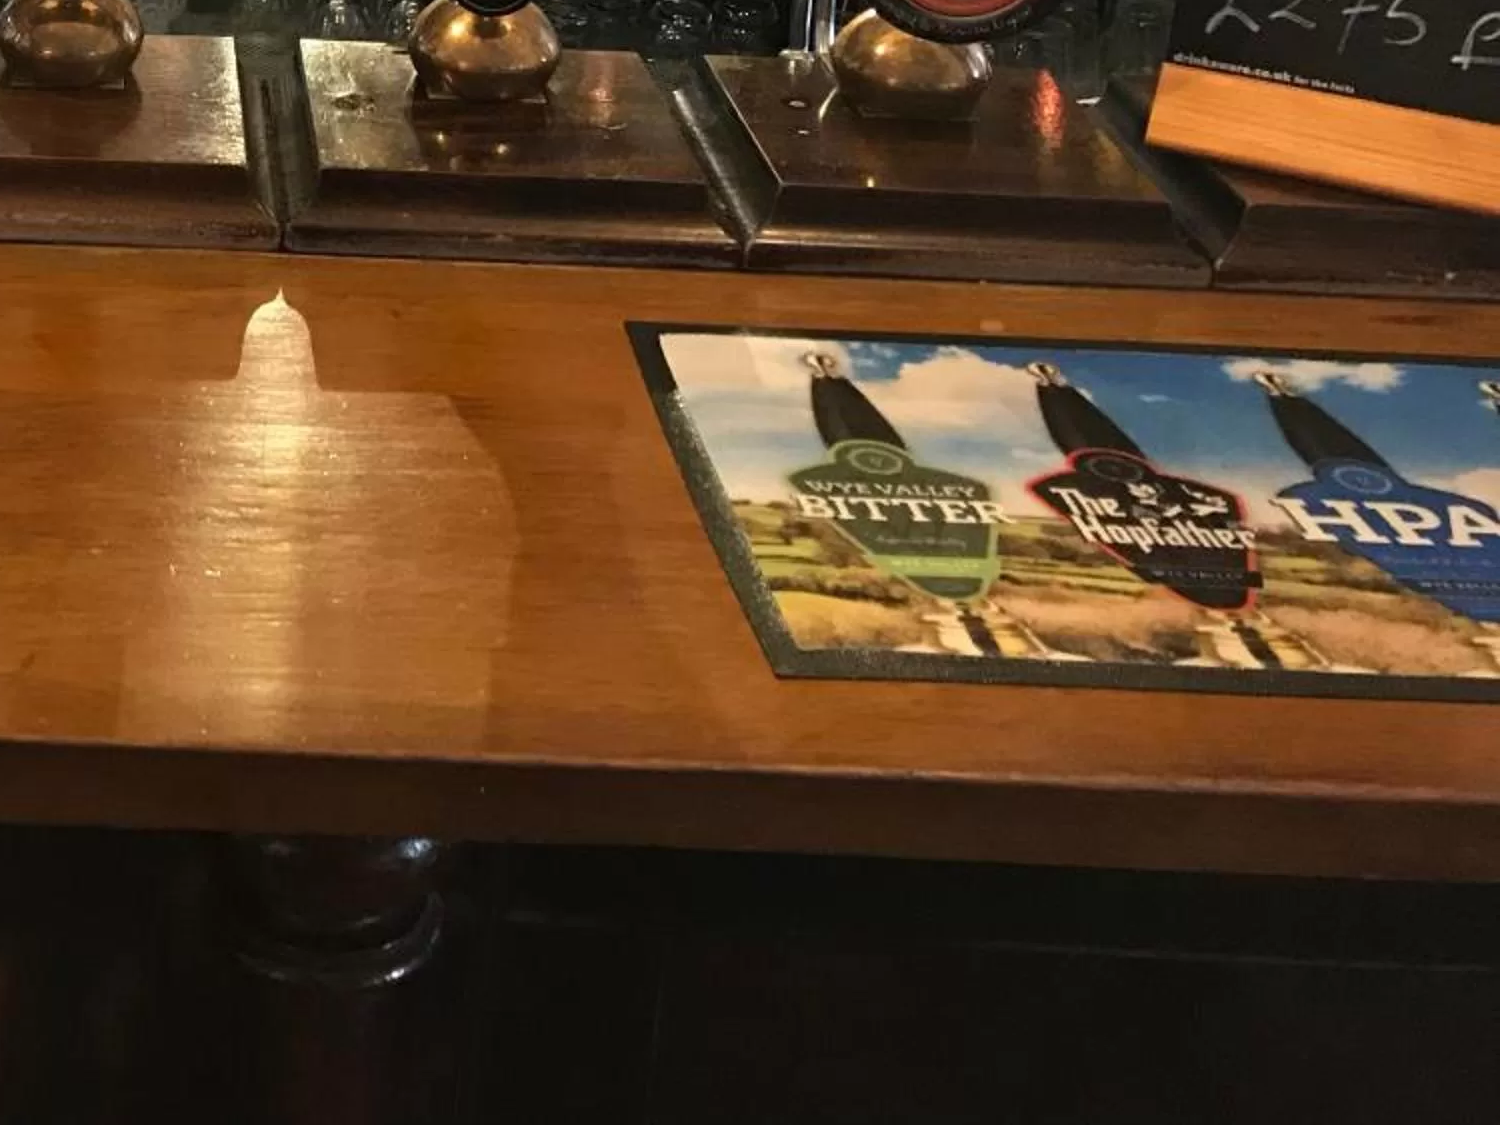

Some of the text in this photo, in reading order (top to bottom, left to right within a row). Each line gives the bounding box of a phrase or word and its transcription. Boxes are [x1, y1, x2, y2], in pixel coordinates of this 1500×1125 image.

[804, 479, 975, 498] WYE VALLEY
[1049, 486, 1127, 517] The
[796, 493, 1017, 524] BITTER
[1270, 499, 1500, 547] HPA
[1070, 513, 1255, 554] Hopfather
